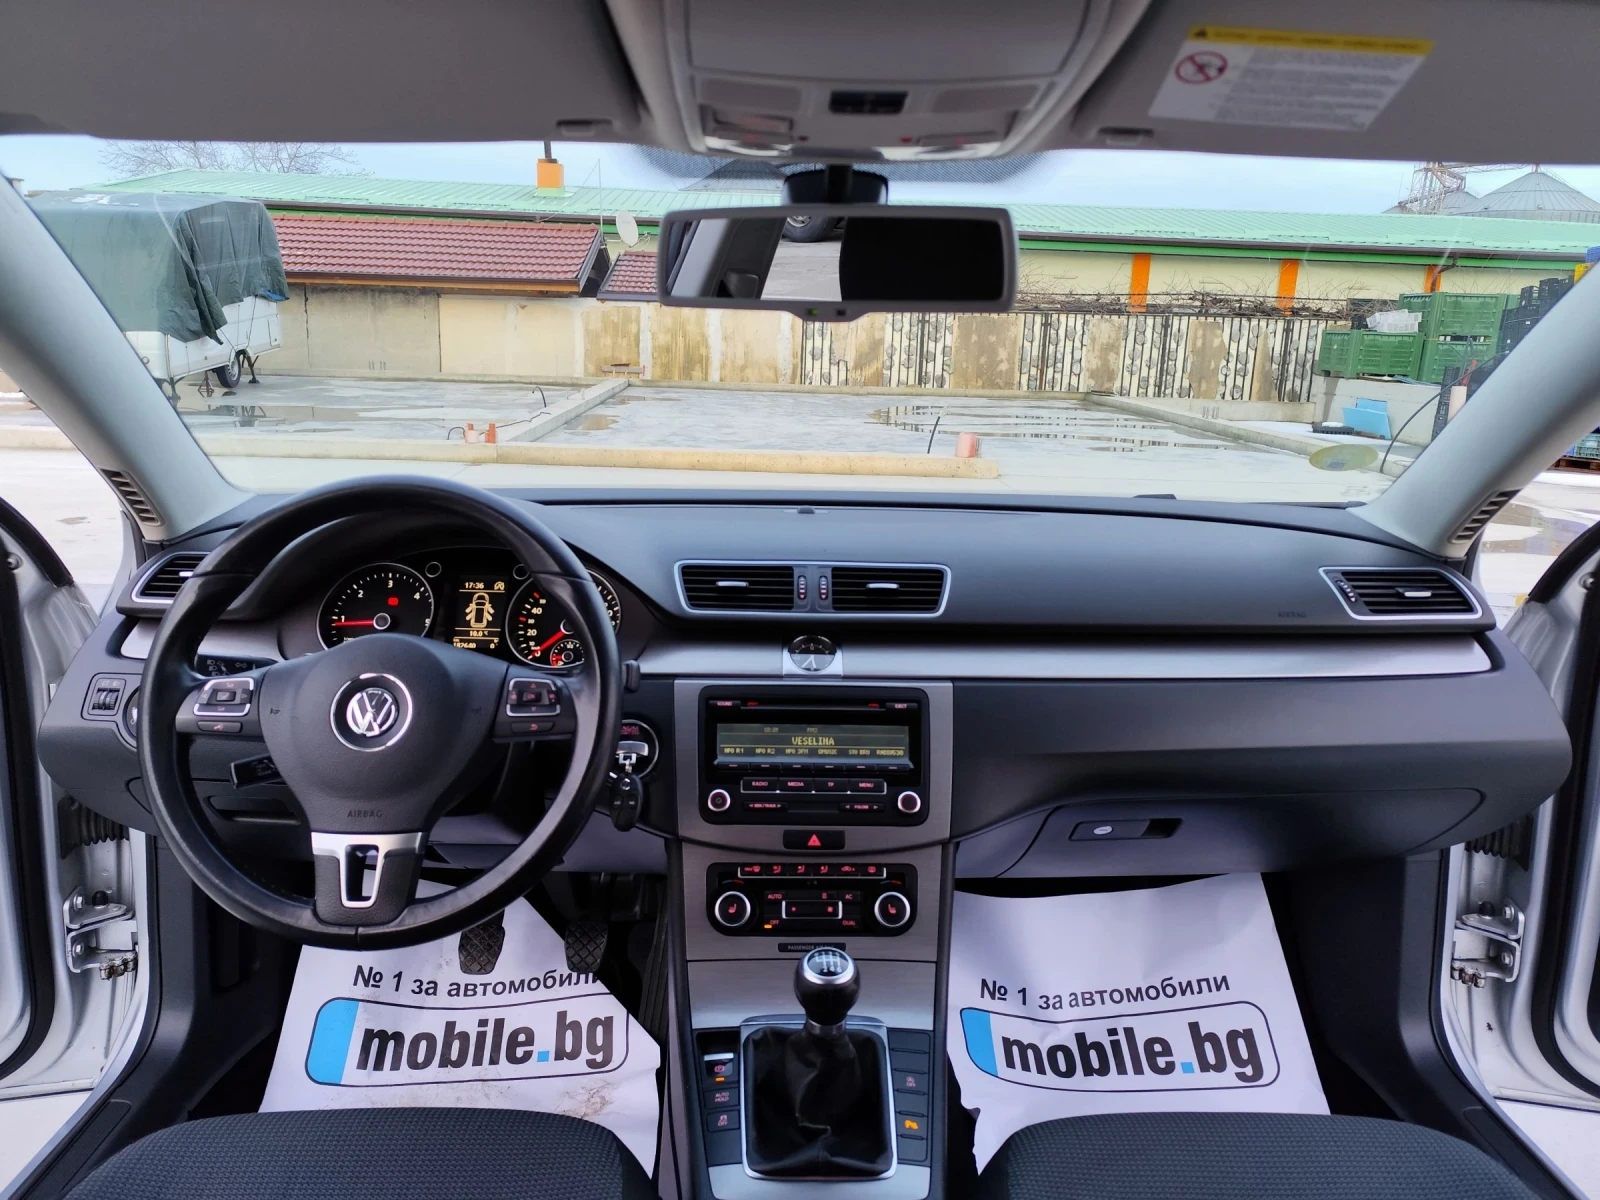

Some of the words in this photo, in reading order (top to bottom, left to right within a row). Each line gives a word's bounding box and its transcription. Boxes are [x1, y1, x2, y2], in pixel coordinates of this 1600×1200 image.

[387, 580, 393, 588] 3
[357, 590, 363, 598] 2
[413, 592, 420, 600] 4
[531, 607, 542, 615] 40
[792, 736, 834, 746] VESELINA
[347, 810, 383, 818] AIRBAG
[353, 965, 383, 989] №
[392, 970, 403, 992] 1
[411, 978, 438, 996] за
[980, 978, 1008, 1001] №
[1017, 987, 1027, 1006] 1
[1038, 995, 1063, 1010] за
[1069, 975, 1230, 1008] автомобили
[356, 1010, 615, 1072] mobile.bg
[1001, 1021, 1265, 1083] mobile.bg
